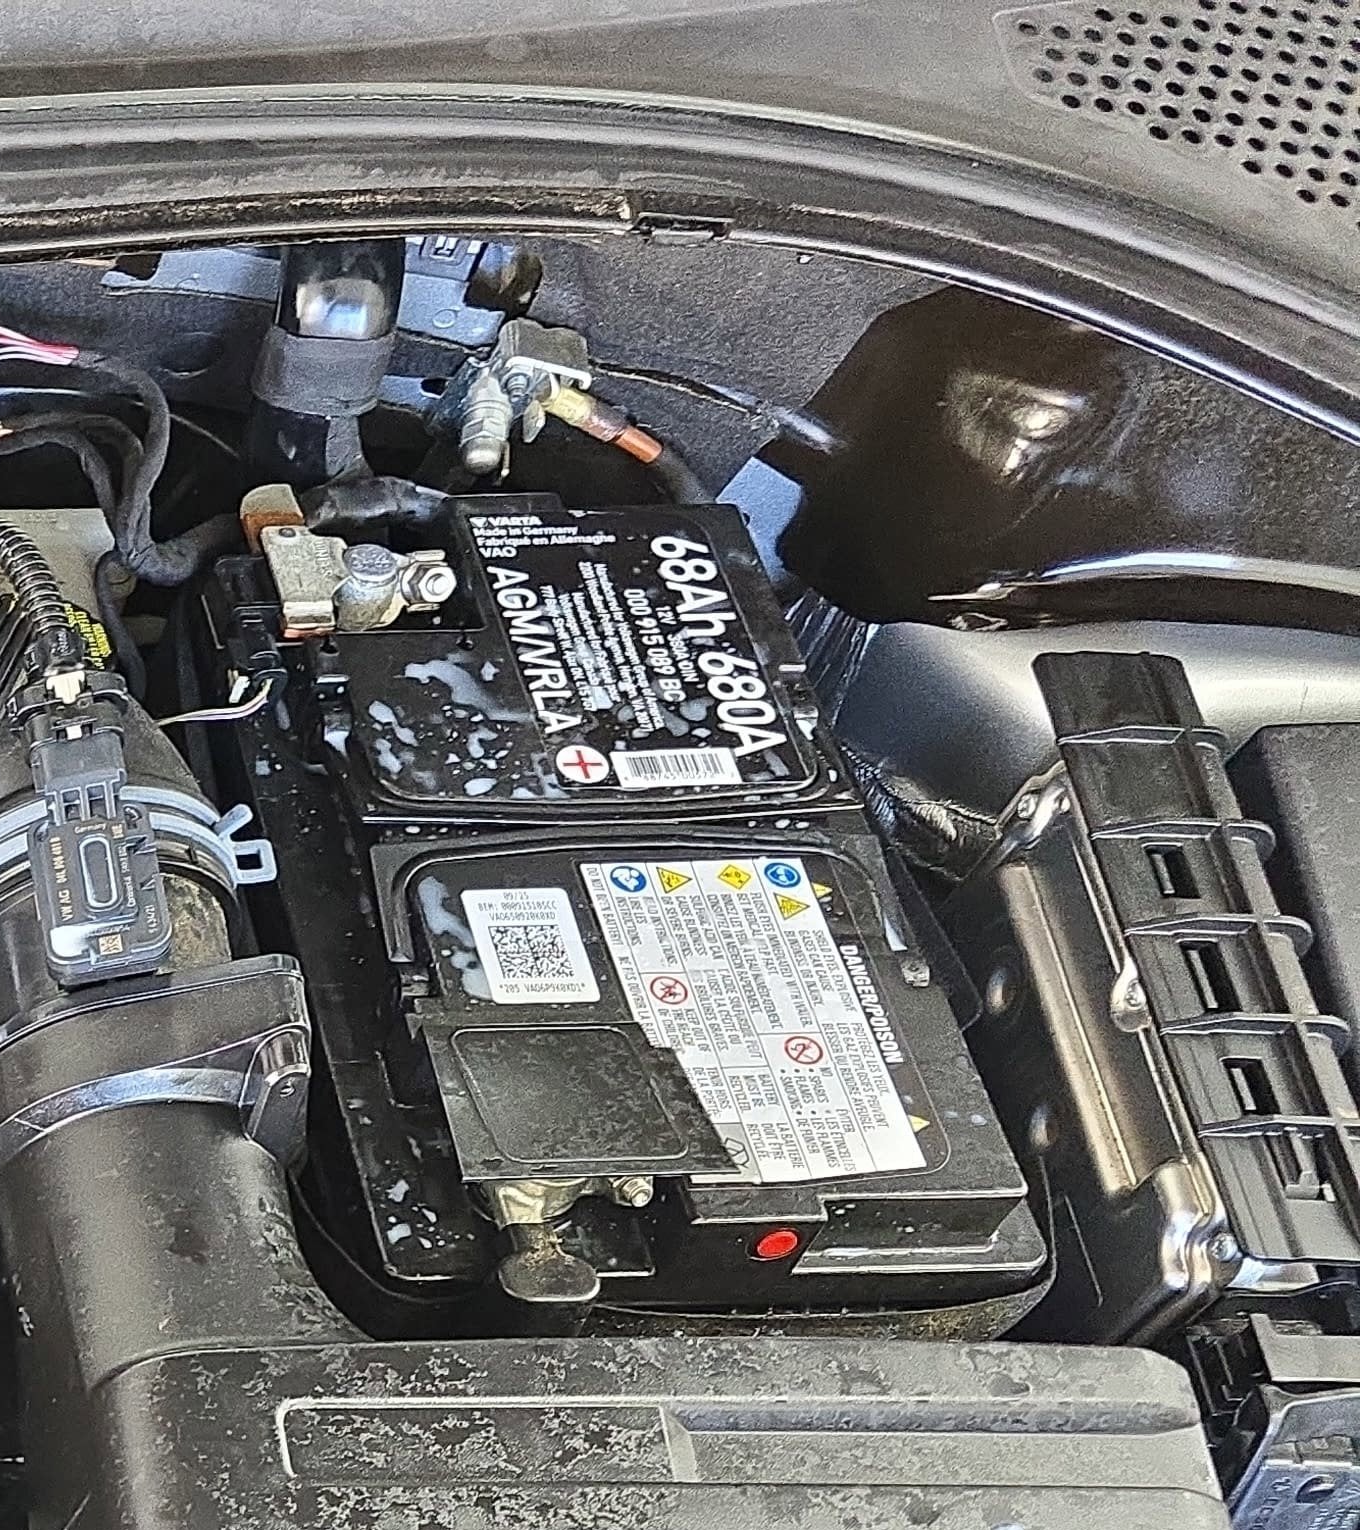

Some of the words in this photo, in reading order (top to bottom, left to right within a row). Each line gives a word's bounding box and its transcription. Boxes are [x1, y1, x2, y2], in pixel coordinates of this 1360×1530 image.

[472, 527, 508, 537] Made
[509, 526, 522, 536] in
[522, 526, 579, 536] Germany
[487, 515, 543, 526] VARTA
[532, 536, 549, 546] en
[550, 534, 617, 546] Allemagne
[620, 588, 655, 616] 000
[653, 604, 677, 624] 12V
[632, 617, 666, 645] 915
[487, 565, 583, 734] AGM/VRLA
[651, 536, 736, 638] 68Ah
[700, 651, 787, 757] 680A
[643, 647, 678, 675] 089
[656, 677, 689, 702] BC
[839, 944, 904, 1064] DANGER/POISON
[835, 1022, 852, 1035] LES
[865, 1059, 882, 1073] LES
